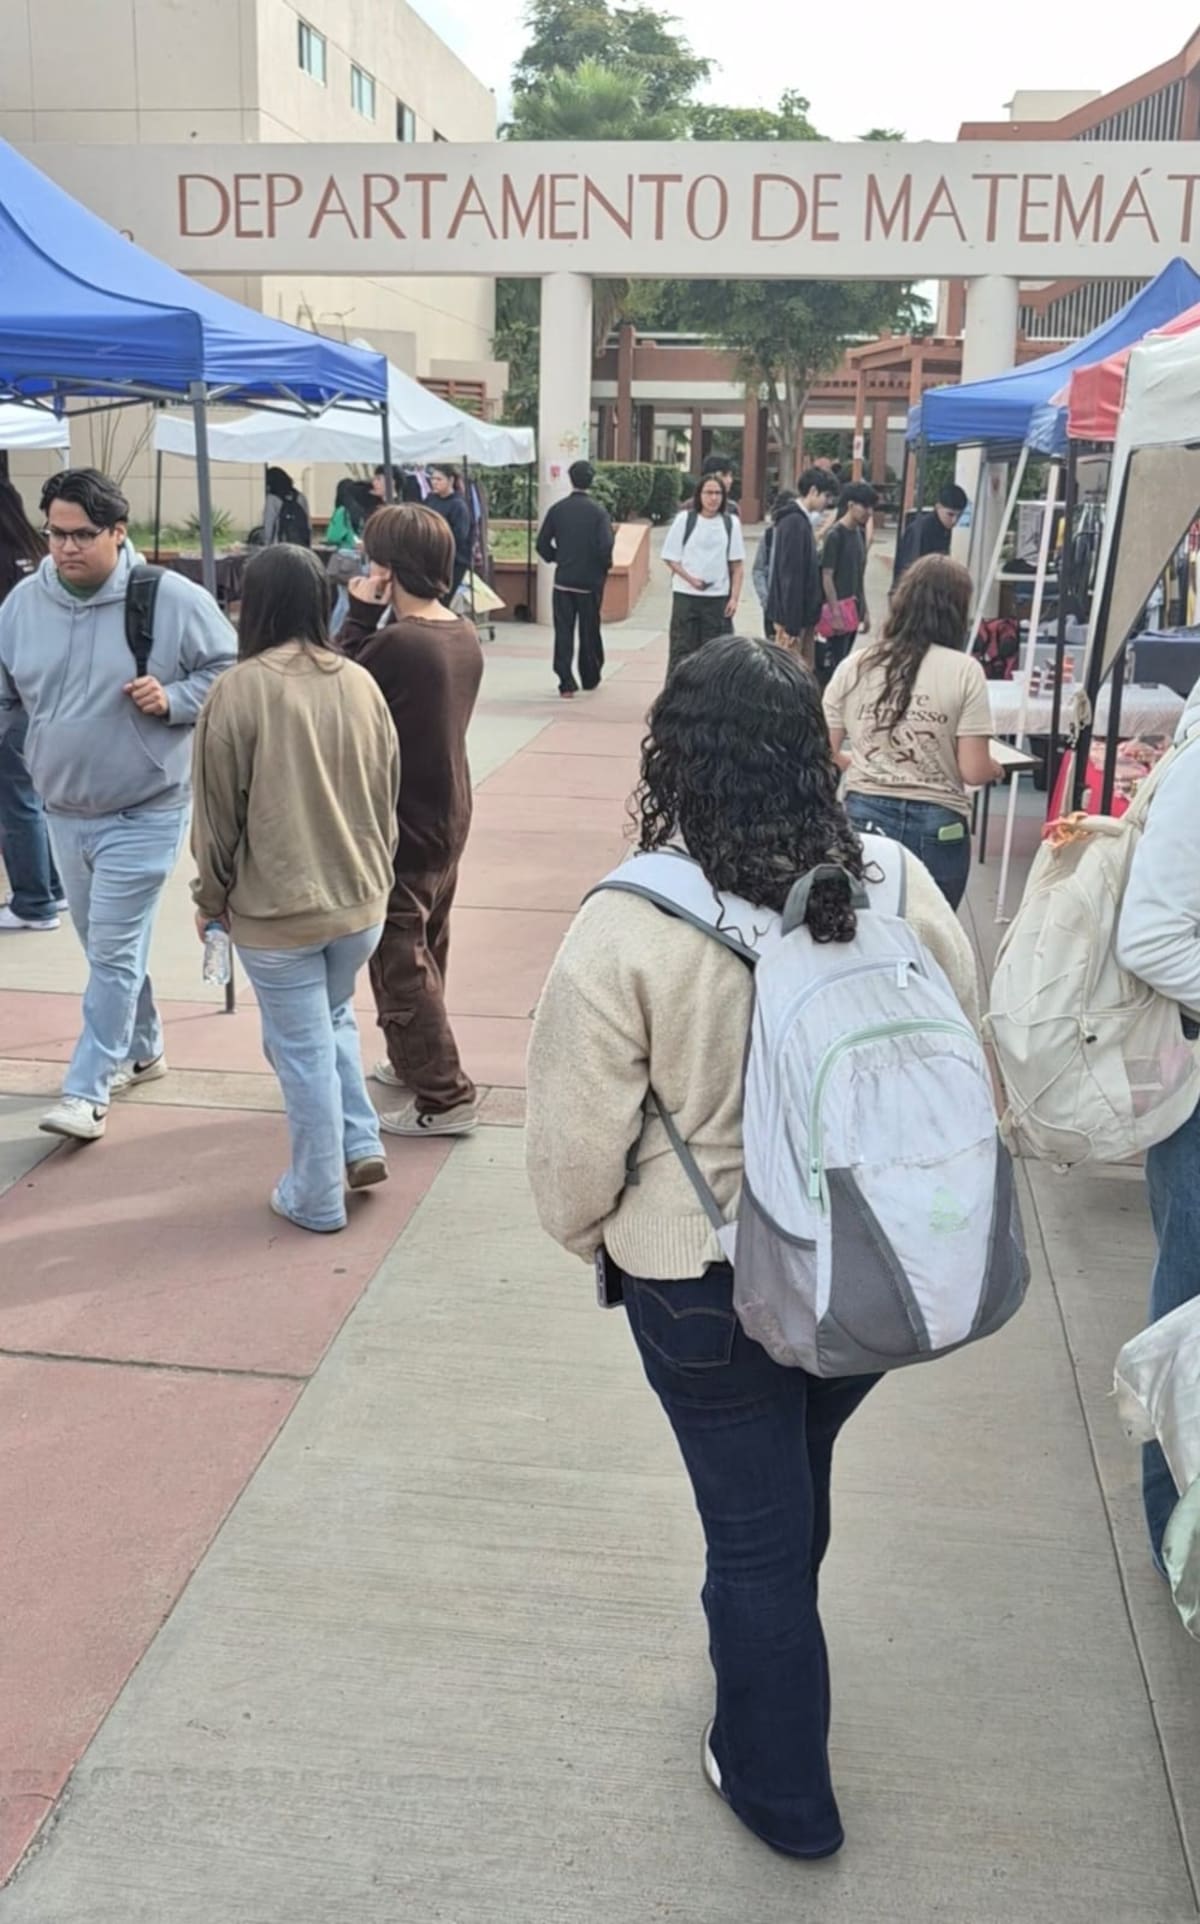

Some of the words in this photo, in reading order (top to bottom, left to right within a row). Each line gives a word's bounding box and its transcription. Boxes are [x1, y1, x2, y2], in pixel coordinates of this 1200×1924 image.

[177, 173, 729, 240] DEPARTAMENTO
[751, 173, 842, 241] DE
[857, 703, 948, 724] Espesso
